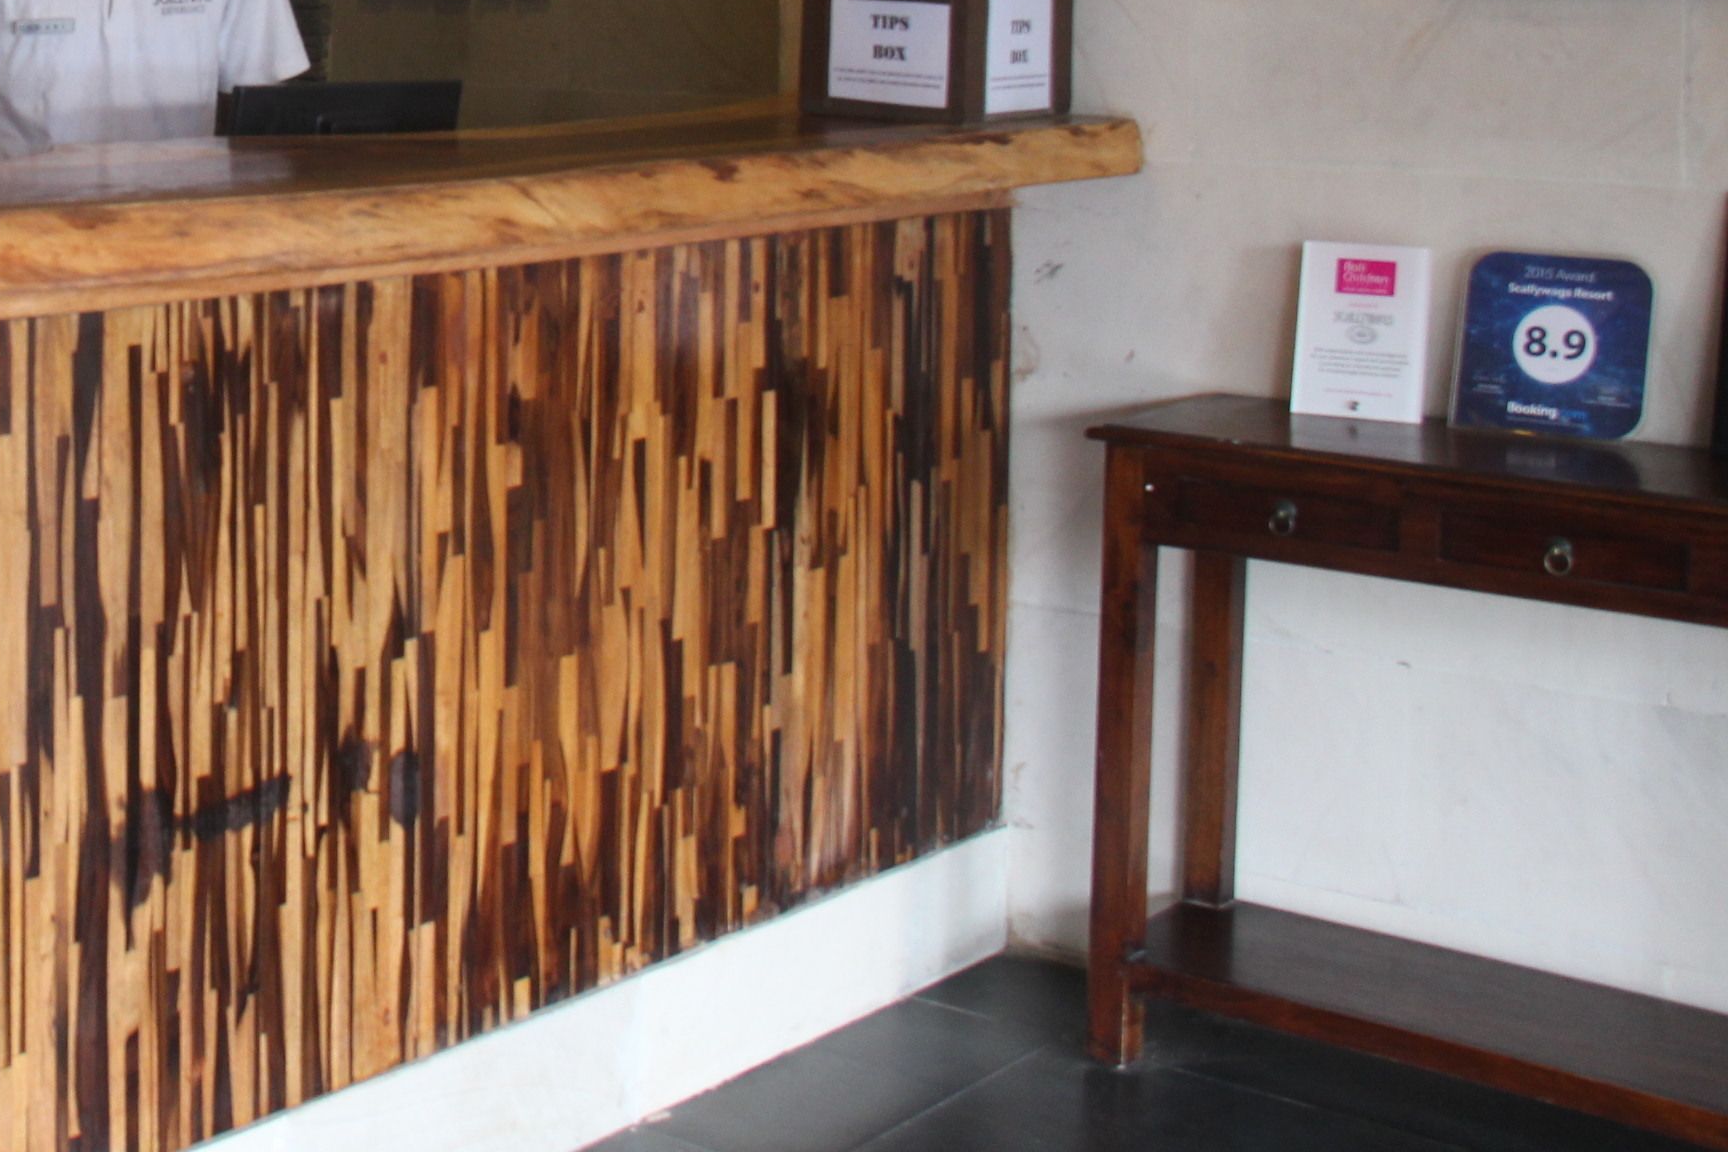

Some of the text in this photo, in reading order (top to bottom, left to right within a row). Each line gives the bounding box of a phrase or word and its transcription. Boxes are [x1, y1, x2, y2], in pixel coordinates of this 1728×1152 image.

[870, 14, 909, 30] TIPS
[1011, 20, 1031, 34] TIPS
[872, 44, 907, 61] BOX
[1009, 49, 1028, 64] BOX
[1556, 268, 1596, 283] Award
[1508, 282, 1613, 302] Scallywags Resort
[1522, 325, 1587, 360] 8.9
